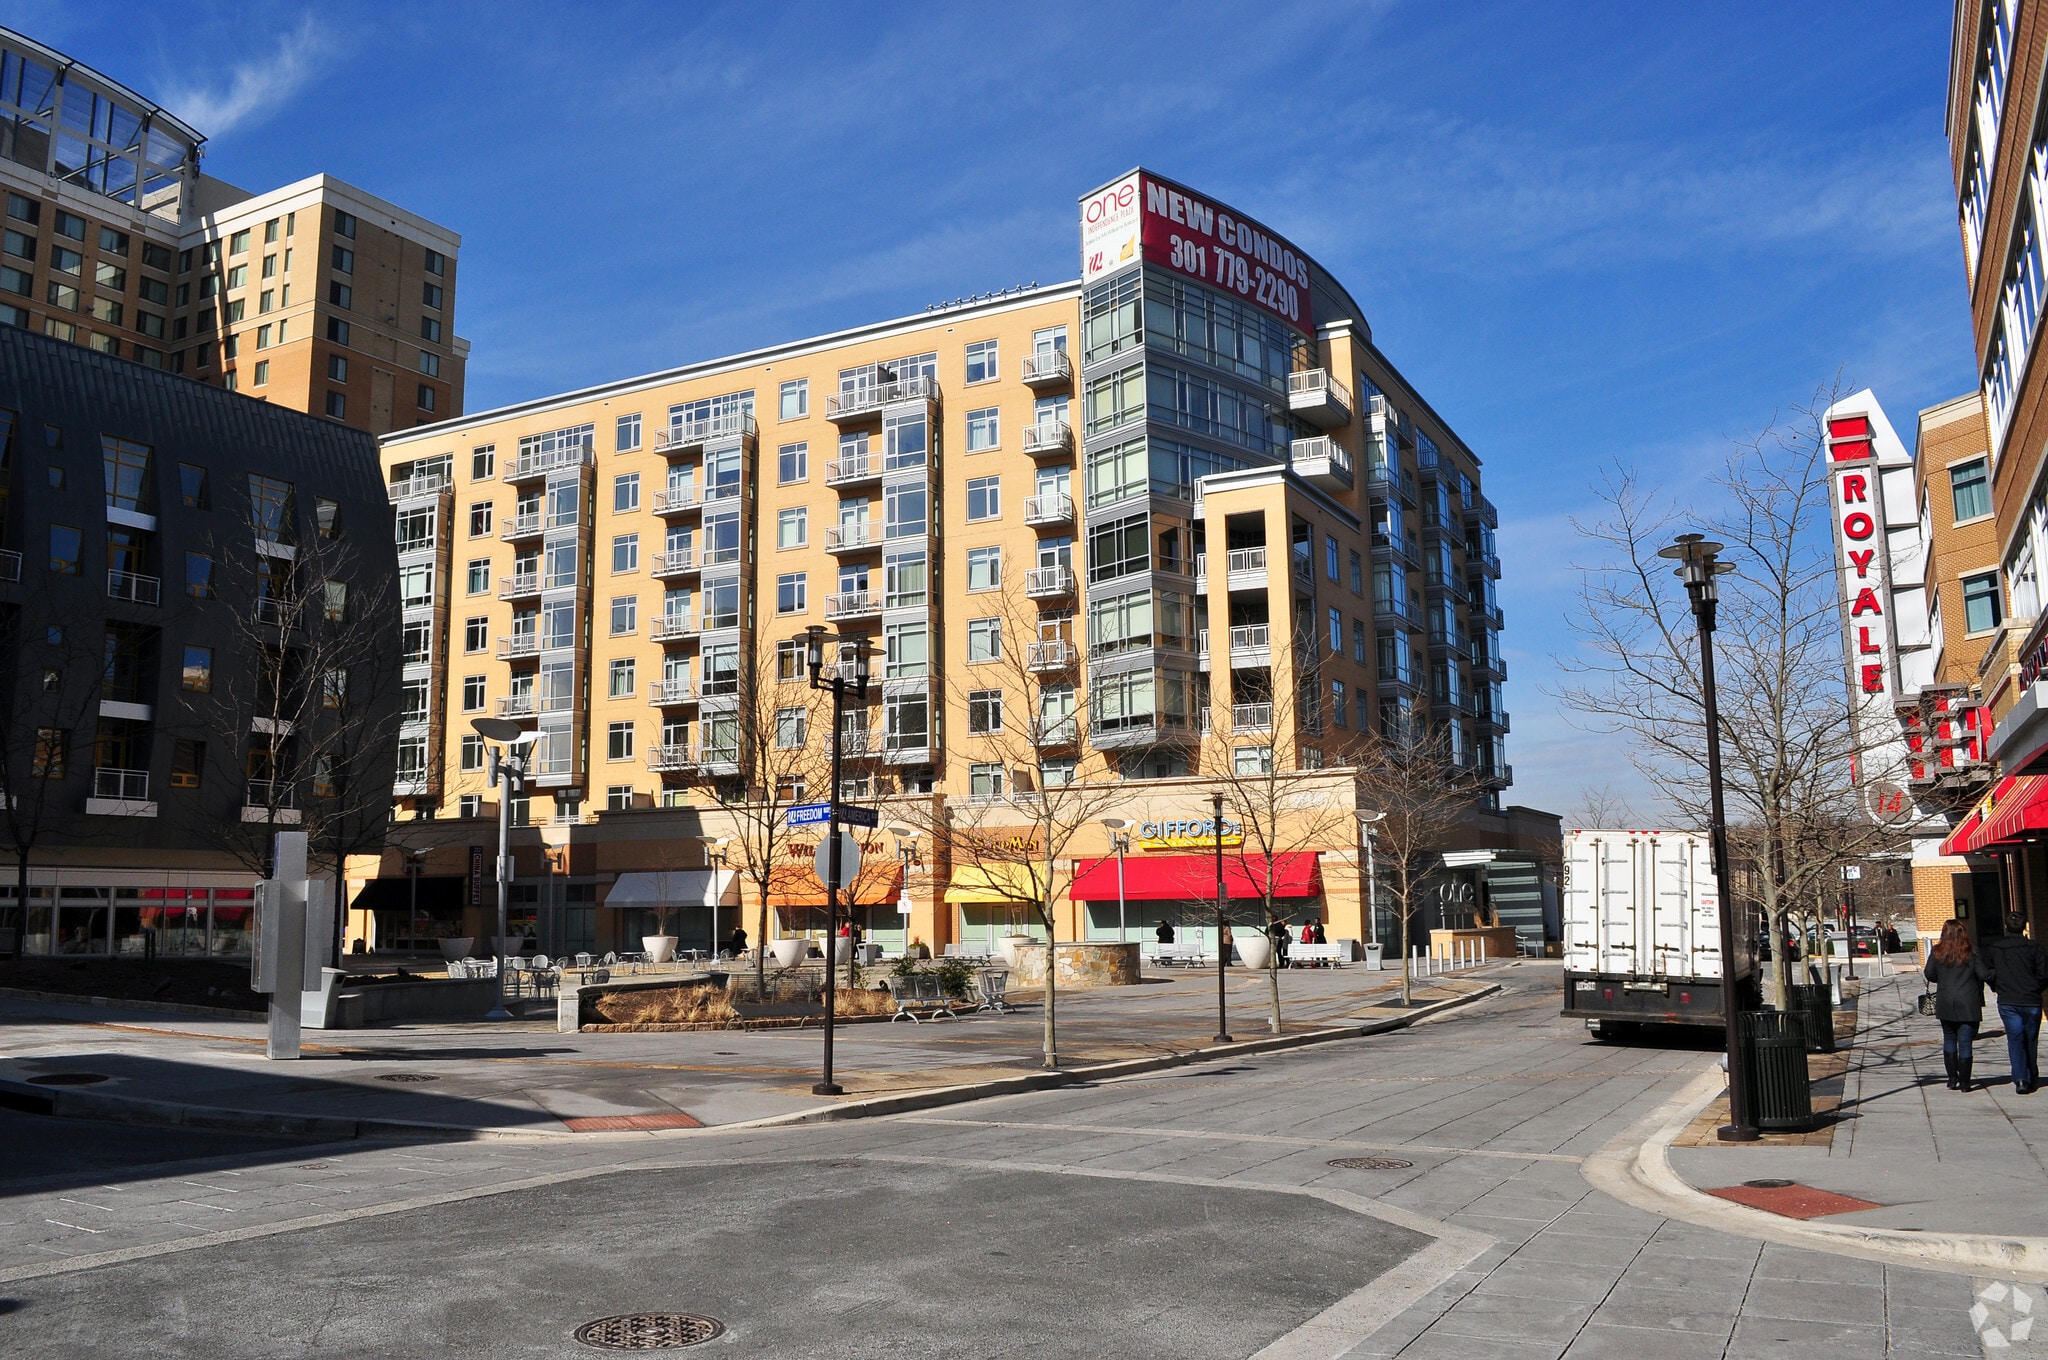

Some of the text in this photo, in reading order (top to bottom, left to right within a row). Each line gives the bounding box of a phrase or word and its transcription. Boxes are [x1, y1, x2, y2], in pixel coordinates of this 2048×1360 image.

[1086, 184, 1134, 223] one
[1147, 181, 1309, 290] NEW CONDOS
[1170, 234, 1299, 322] 301 779-2290
[1842, 473, 1884, 694] ROYALE
[796, 807, 823, 822] FREEDOM
[1878, 790, 1903, 815] 14
[847, 809, 871, 824] AMERICA
[473, 854, 481, 875] CHINA
[473, 877, 481, 903] BUFFET
